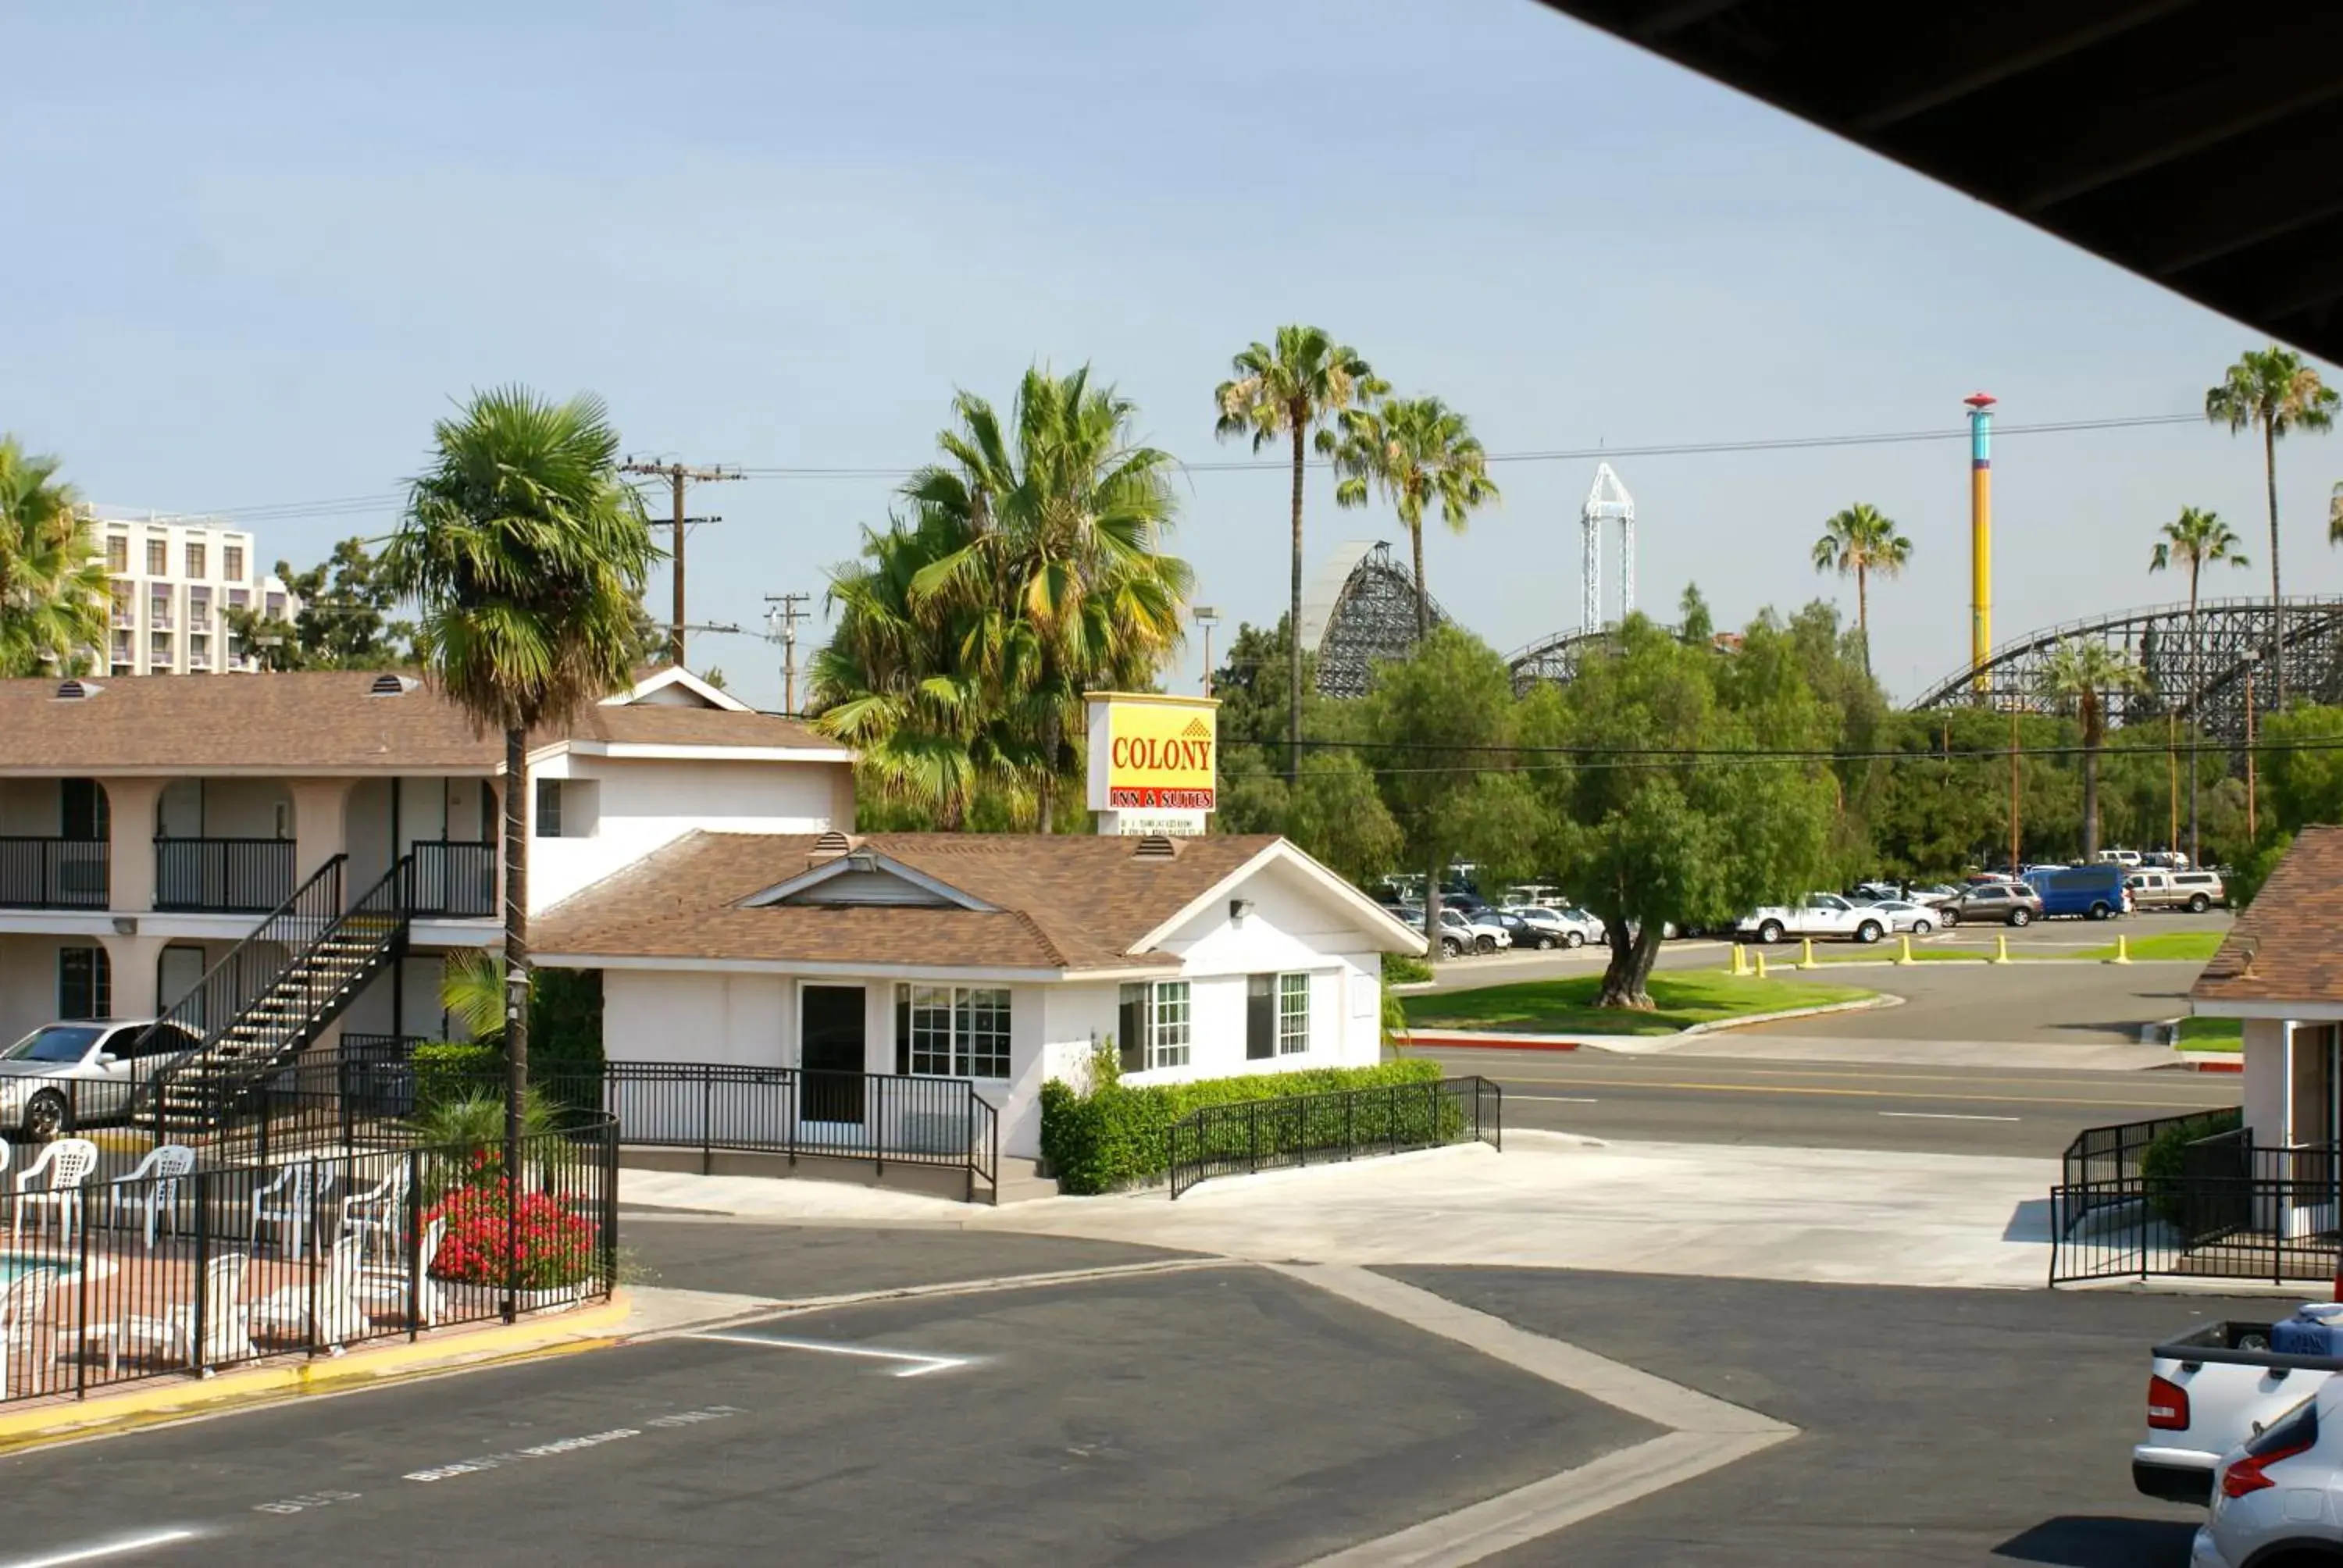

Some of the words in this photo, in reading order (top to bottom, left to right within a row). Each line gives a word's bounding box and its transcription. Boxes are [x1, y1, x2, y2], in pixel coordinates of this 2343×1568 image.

[1112, 736, 1212, 771] COLONY
[1112, 790, 1140, 807] INN
[1146, 791, 1155, 806] &
[1161, 791, 1211, 807] SUITES
